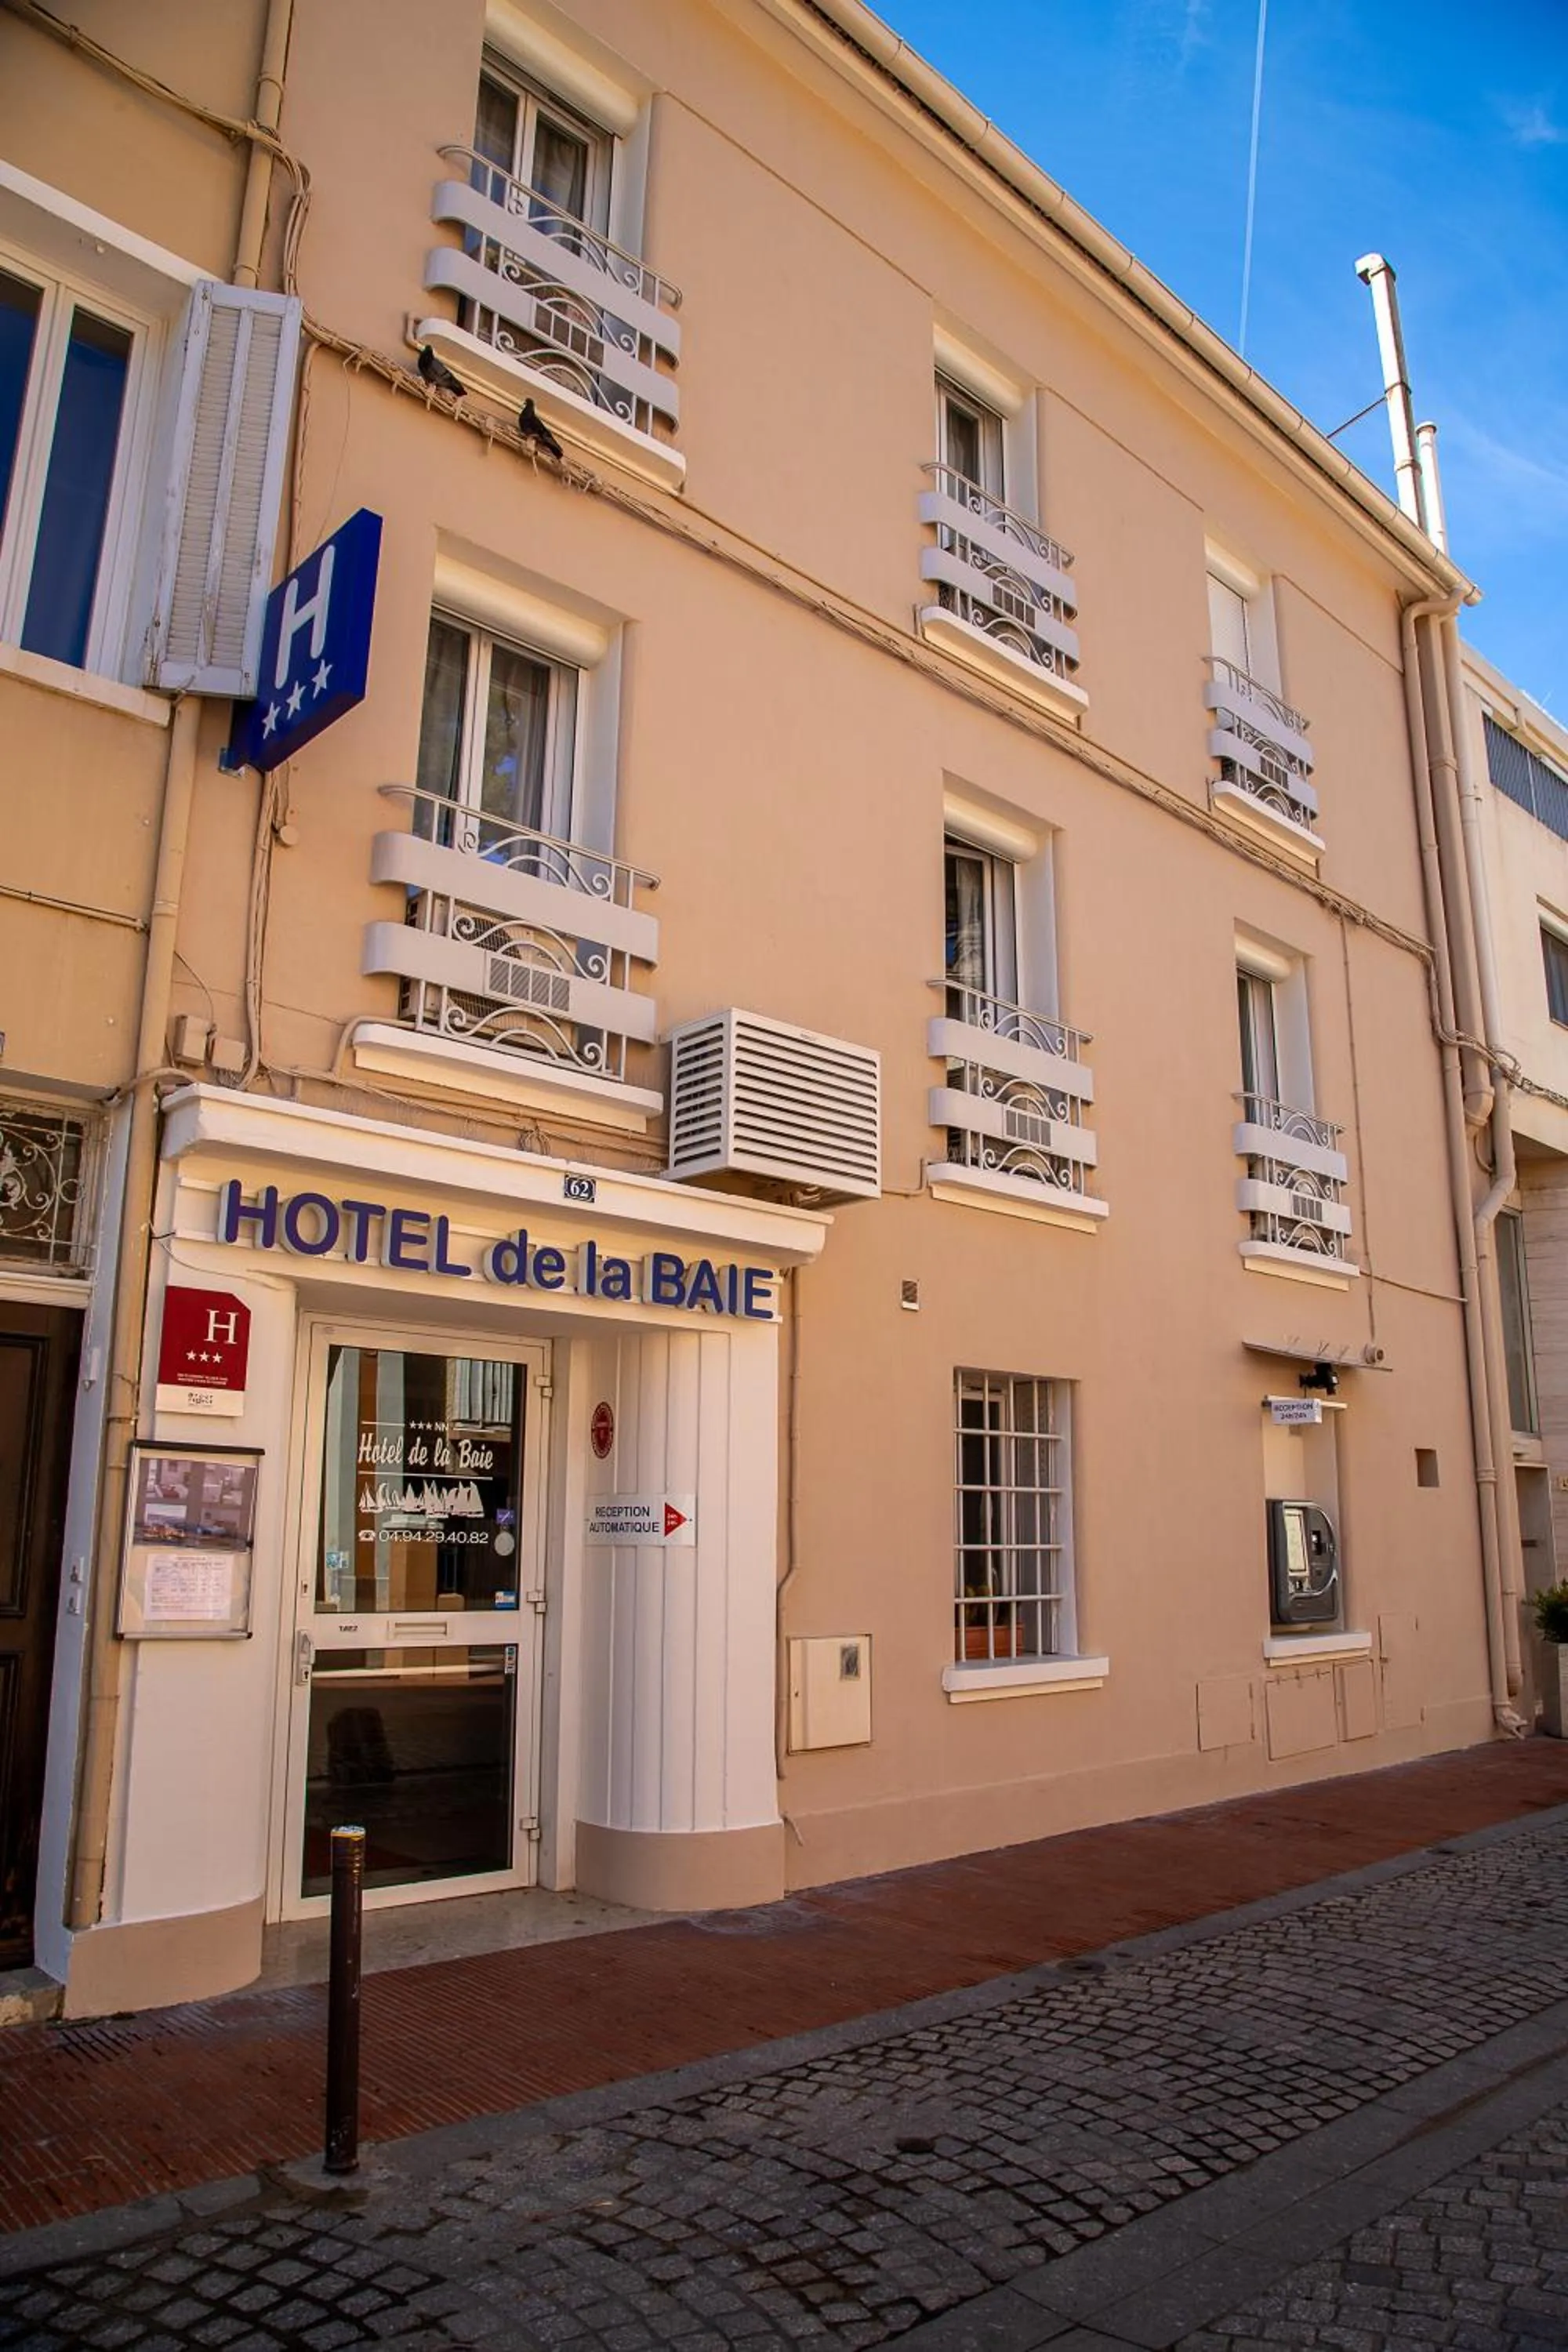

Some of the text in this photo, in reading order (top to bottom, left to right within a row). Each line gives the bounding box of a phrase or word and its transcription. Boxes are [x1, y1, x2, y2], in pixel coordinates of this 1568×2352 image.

[275, 545, 336, 690] H
[570, 1180, 590, 1198] 62
[223, 1178, 775, 1320] HOTEL de la BAIE
[203, 1308, 239, 1345] H
[358, 1432, 494, 1470] Hotel de la Baie
[595, 1506, 651, 1518] RECEPTION
[378, 1530, 489, 1544] 04.94.29.40.82
[589, 1521, 661, 1534] AUTOMATIQUE
